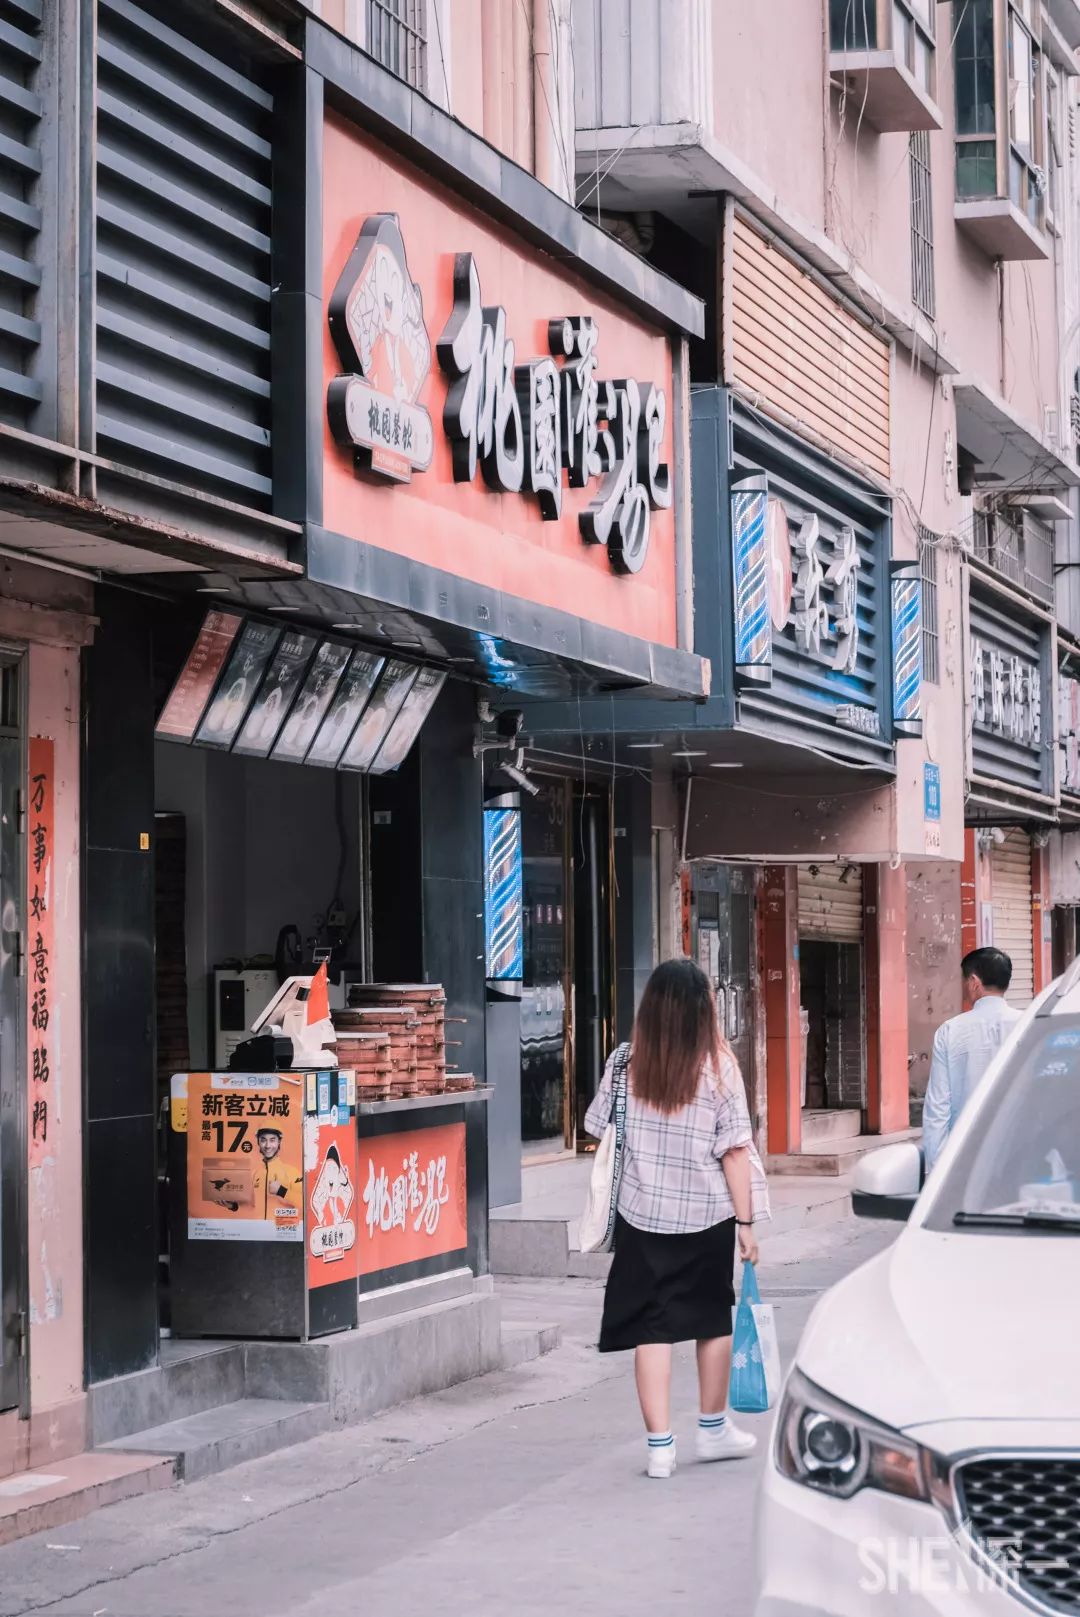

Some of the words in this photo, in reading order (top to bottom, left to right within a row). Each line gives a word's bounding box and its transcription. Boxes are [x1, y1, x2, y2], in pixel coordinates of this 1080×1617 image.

[202, 1094, 290, 1117] 新客立减
[202, 1120, 211, 1141] 最高
[212, 1121, 249, 1153] 17
